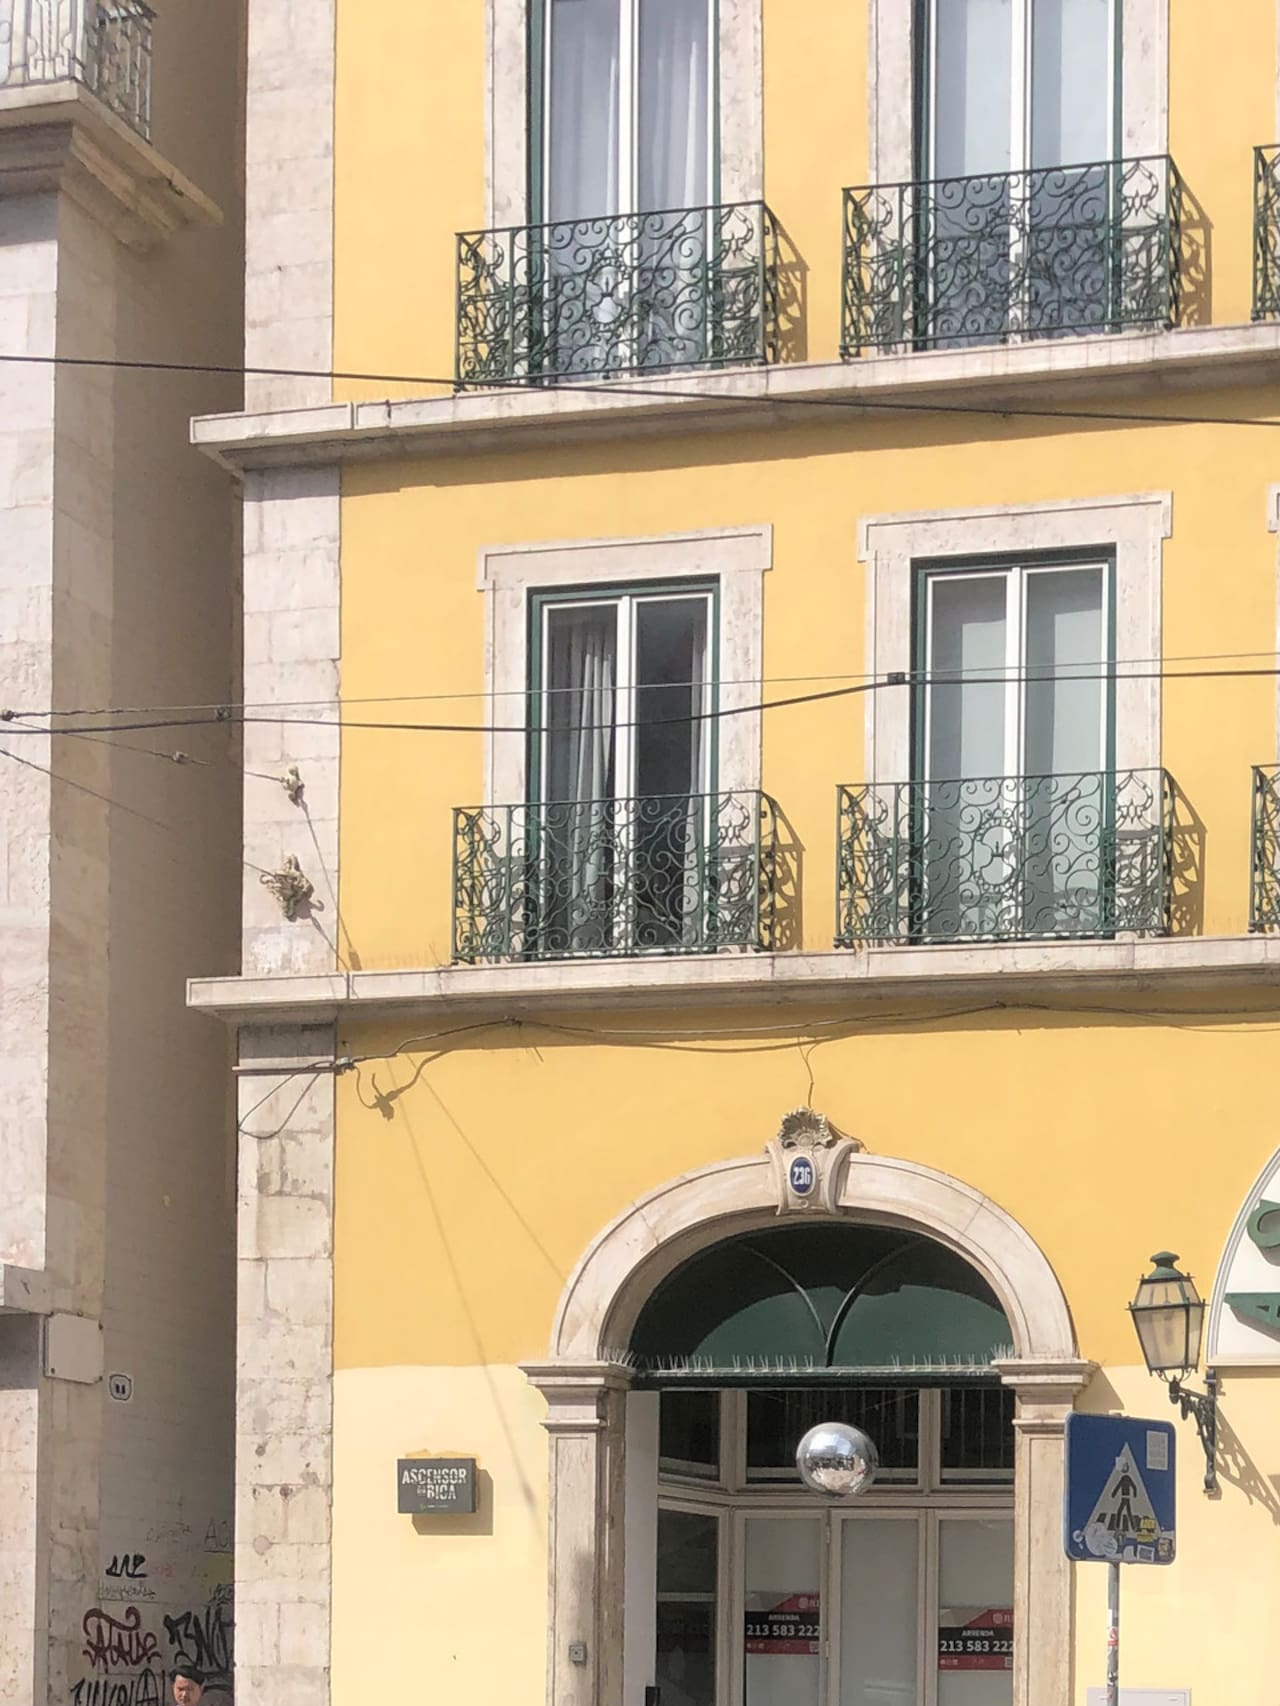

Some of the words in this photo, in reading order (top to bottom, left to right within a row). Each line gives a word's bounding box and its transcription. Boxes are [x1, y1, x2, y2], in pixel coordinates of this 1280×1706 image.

[793, 1166, 811, 1185] 236
[401, 1468, 467, 1485] ASCENSOR
[426, 1484, 457, 1500] BICA
[746, 1624, 769, 1636] 213
[772, 1624, 795, 1636] 583
[940, 1640, 963, 1652] 213
[966, 1640, 990, 1652] 583
